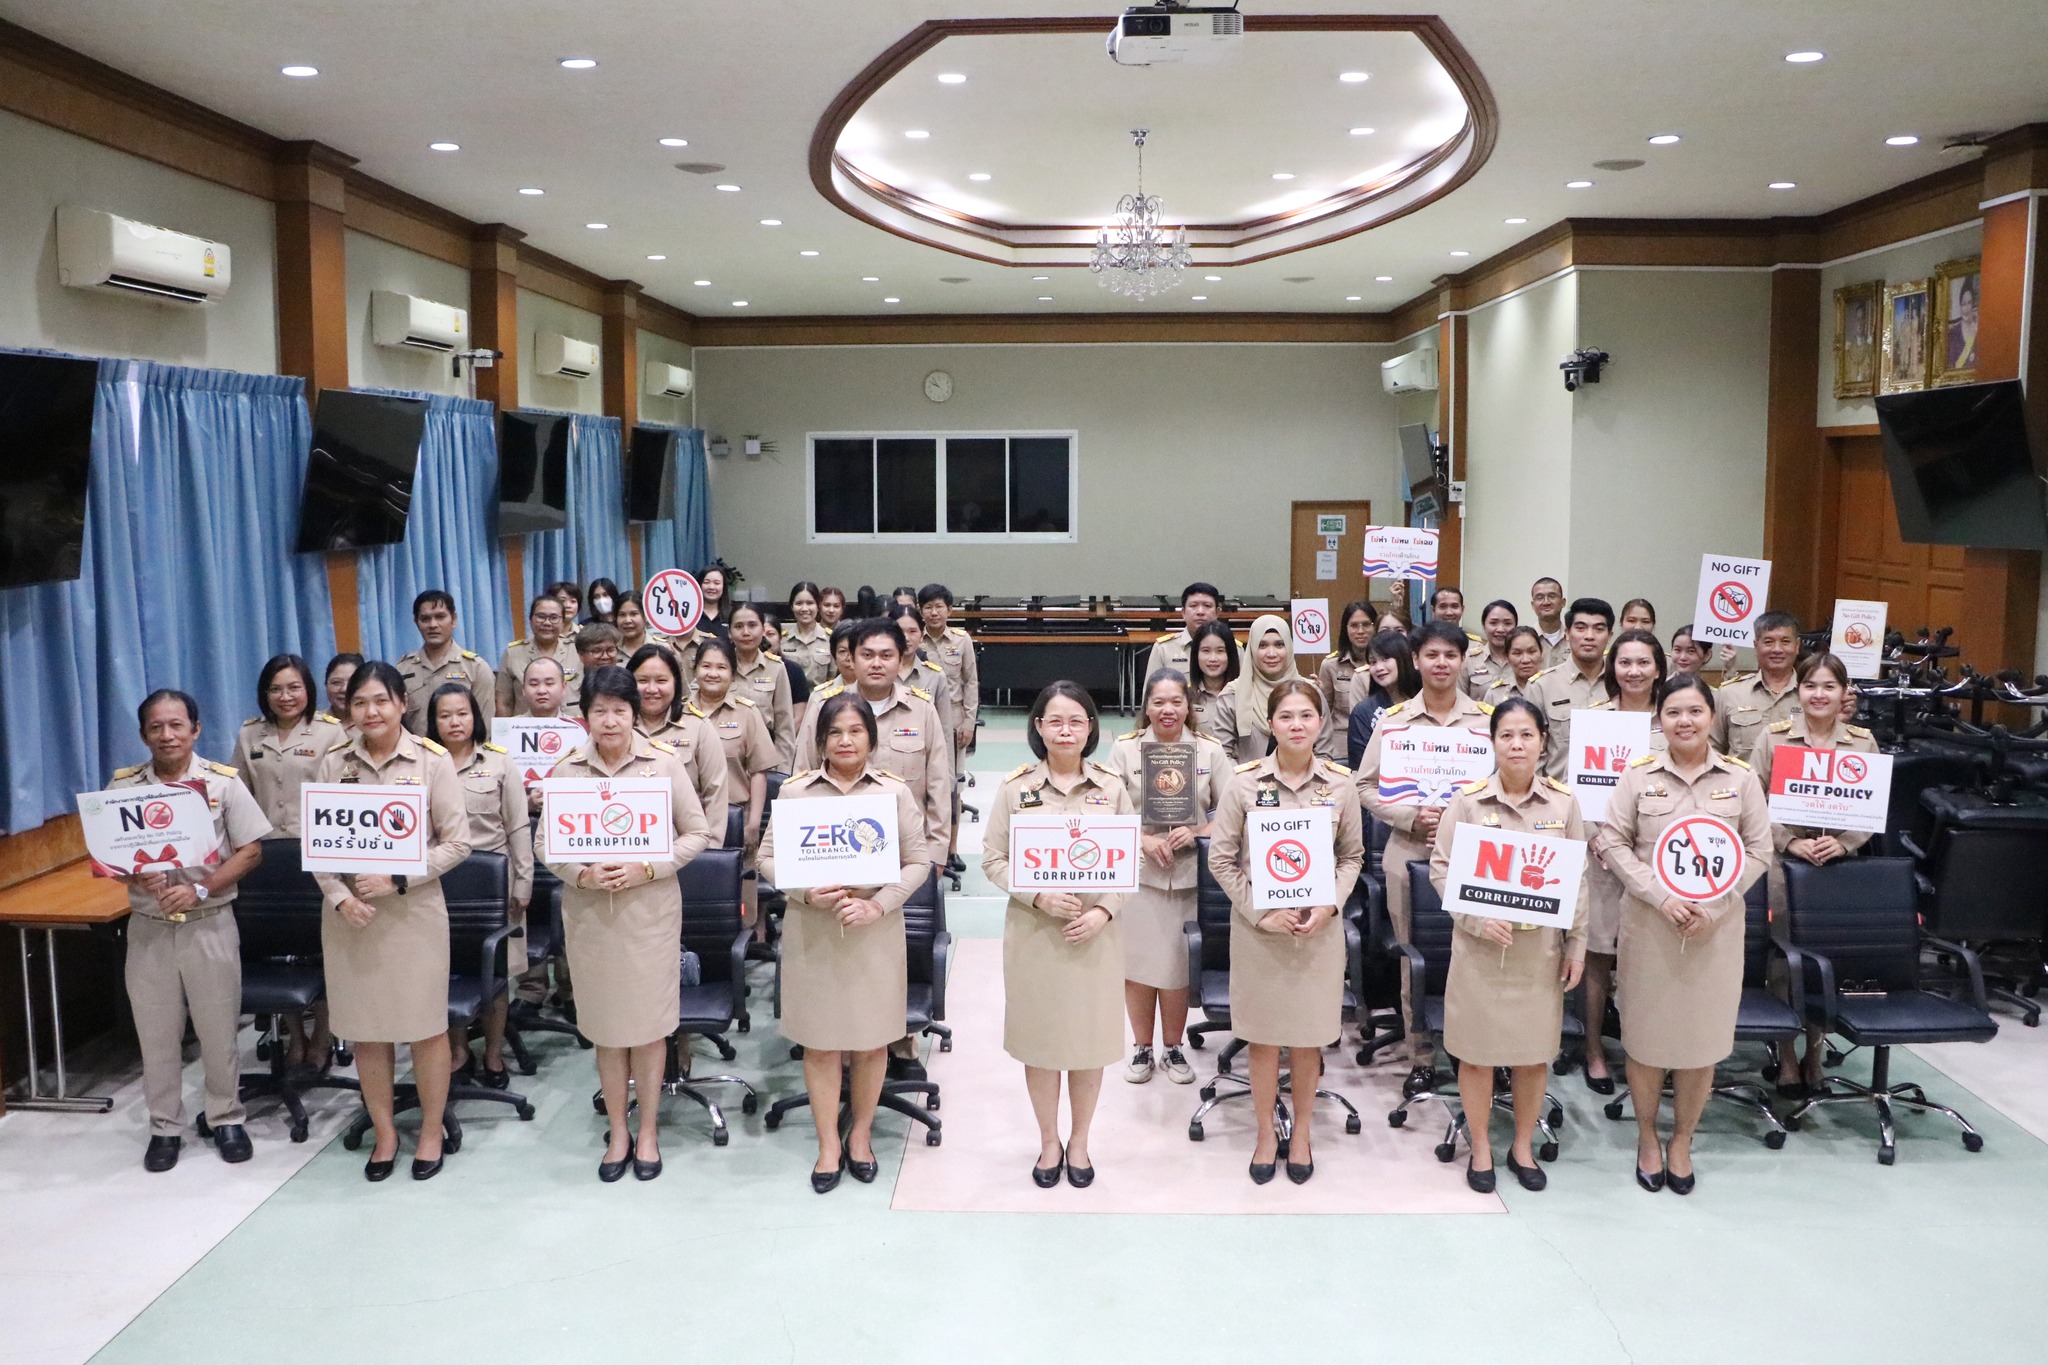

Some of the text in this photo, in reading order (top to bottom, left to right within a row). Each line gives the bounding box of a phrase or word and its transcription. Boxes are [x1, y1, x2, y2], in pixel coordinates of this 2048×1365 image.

[1711, 562, 1760, 576] NO GIFT
[652, 586, 690, 618] โกง
[1298, 616, 1320, 634] โกง
[1705, 626, 1749, 640] POLICY
[1390, 740, 1487, 755] ไม่ทำ ไม่ทน ไม่เฉย
[1404, 765, 1467, 776] รวมไทยต้านโกง
[1580, 776, 1619, 785] CORRUPT
[1789, 783, 1873, 800] GIFT POLICY
[315, 808, 379, 835] หยุด
[1261, 820, 1311, 832] NO GIFT
[313, 834, 393, 850] คอร์รัปชั่น
[568, 836, 650, 847] CORRUPTION
[801, 846, 849, 855] TOLERANCE
[1668, 838, 1724, 878] โกง
[1034, 871, 1116, 880] CORRUPTION
[1268, 887, 1312, 899] POLICY
[1465, 888, 1553, 910] CORRUPTION
